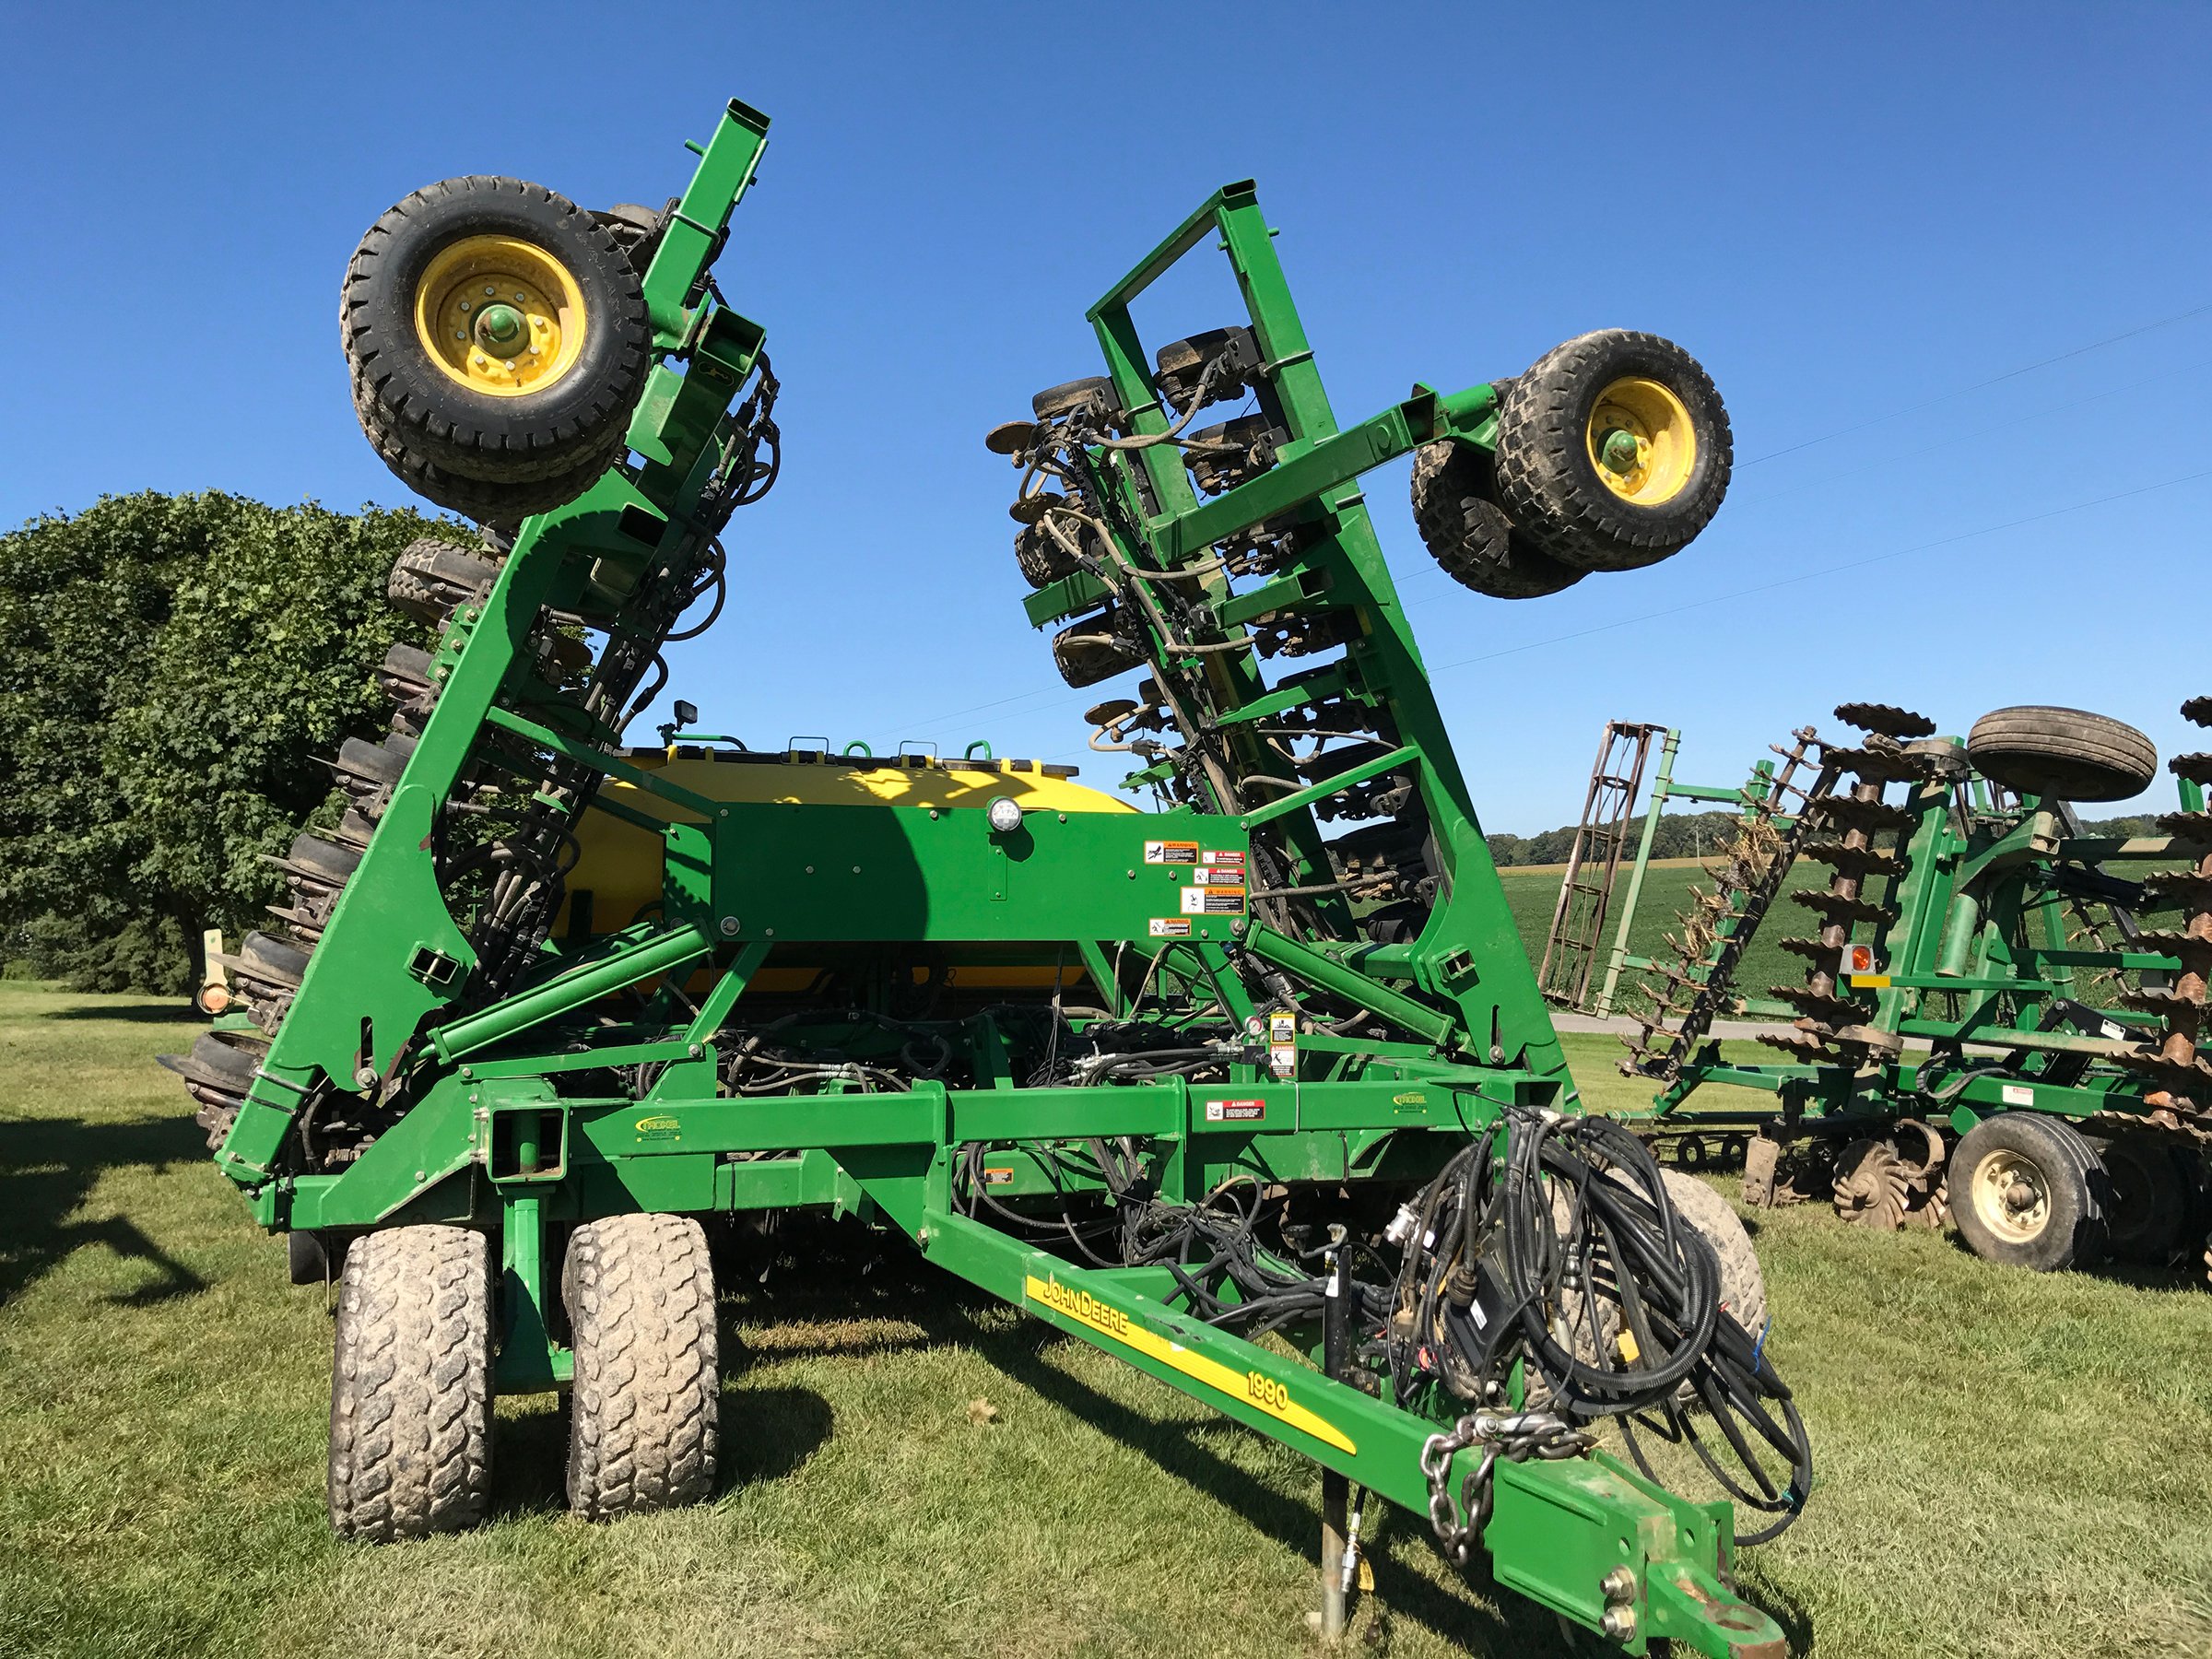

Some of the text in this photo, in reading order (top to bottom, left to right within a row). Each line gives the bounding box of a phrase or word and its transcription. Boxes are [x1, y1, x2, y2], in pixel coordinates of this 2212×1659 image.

[1043, 1278, 1129, 1336] JOHN DEERE
[1247, 1371, 1288, 1411] 1990
